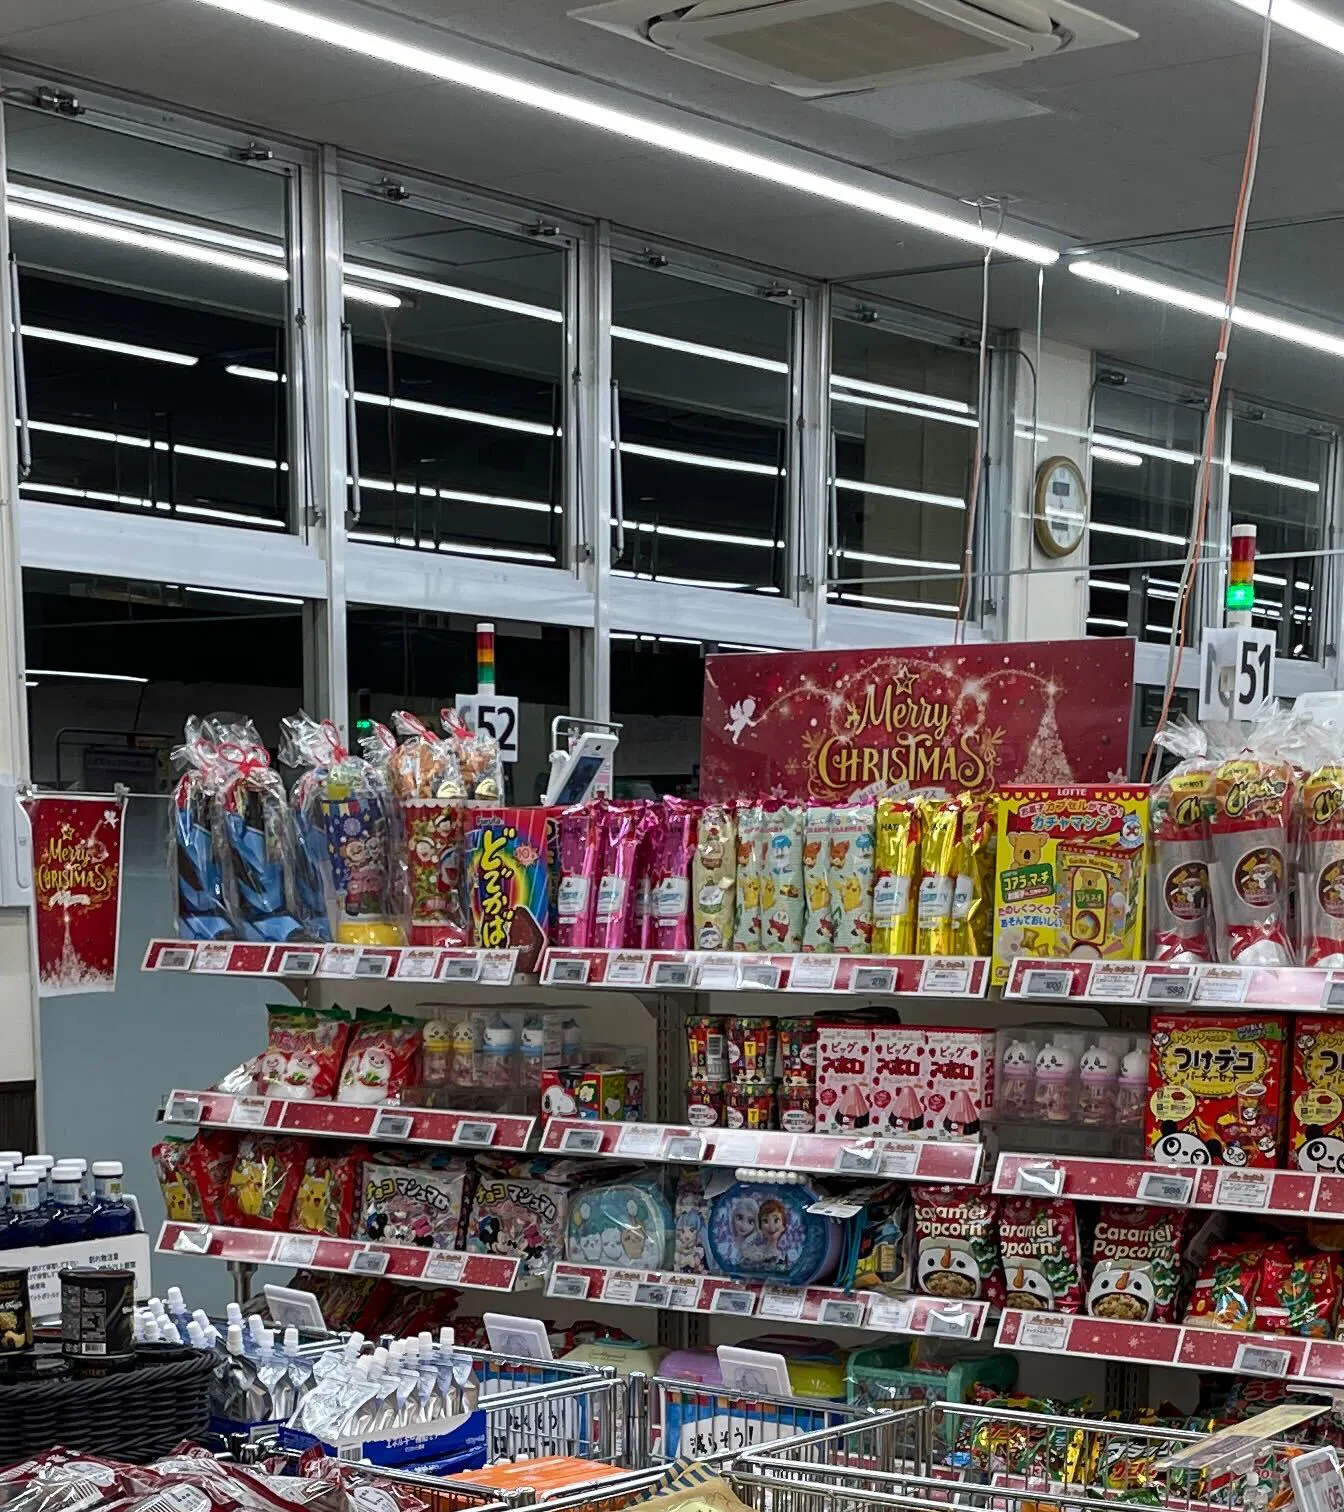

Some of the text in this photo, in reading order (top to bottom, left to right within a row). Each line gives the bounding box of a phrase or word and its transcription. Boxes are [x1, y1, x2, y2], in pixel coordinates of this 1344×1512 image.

[1238, 641, 1274, 705] 51
[855, 684, 952, 740] Merry
[478, 704, 517, 752] 52
[818, 731, 986, 789] CHRISTMAS
[1057, 788, 1087, 797] LOTTE
[47, 838, 92, 869] Merry
[36, 863, 110, 895] CHRISTMAS
[831, 1042, 856, 1055] ビッグ
[885, 1043, 911, 1057] ビッグ
[939, 1045, 965, 1059] ビッグ
[821, 1056, 865, 1075] アポロ
[876, 1057, 921, 1078] アポロ
[929, 1059, 975, 1081] アポロ
[1173, 1046, 1255, 1074] つけデコ
[1094, 1222, 1175, 1243] Caramel
[1093, 1238, 1172, 1258] Popcorn
